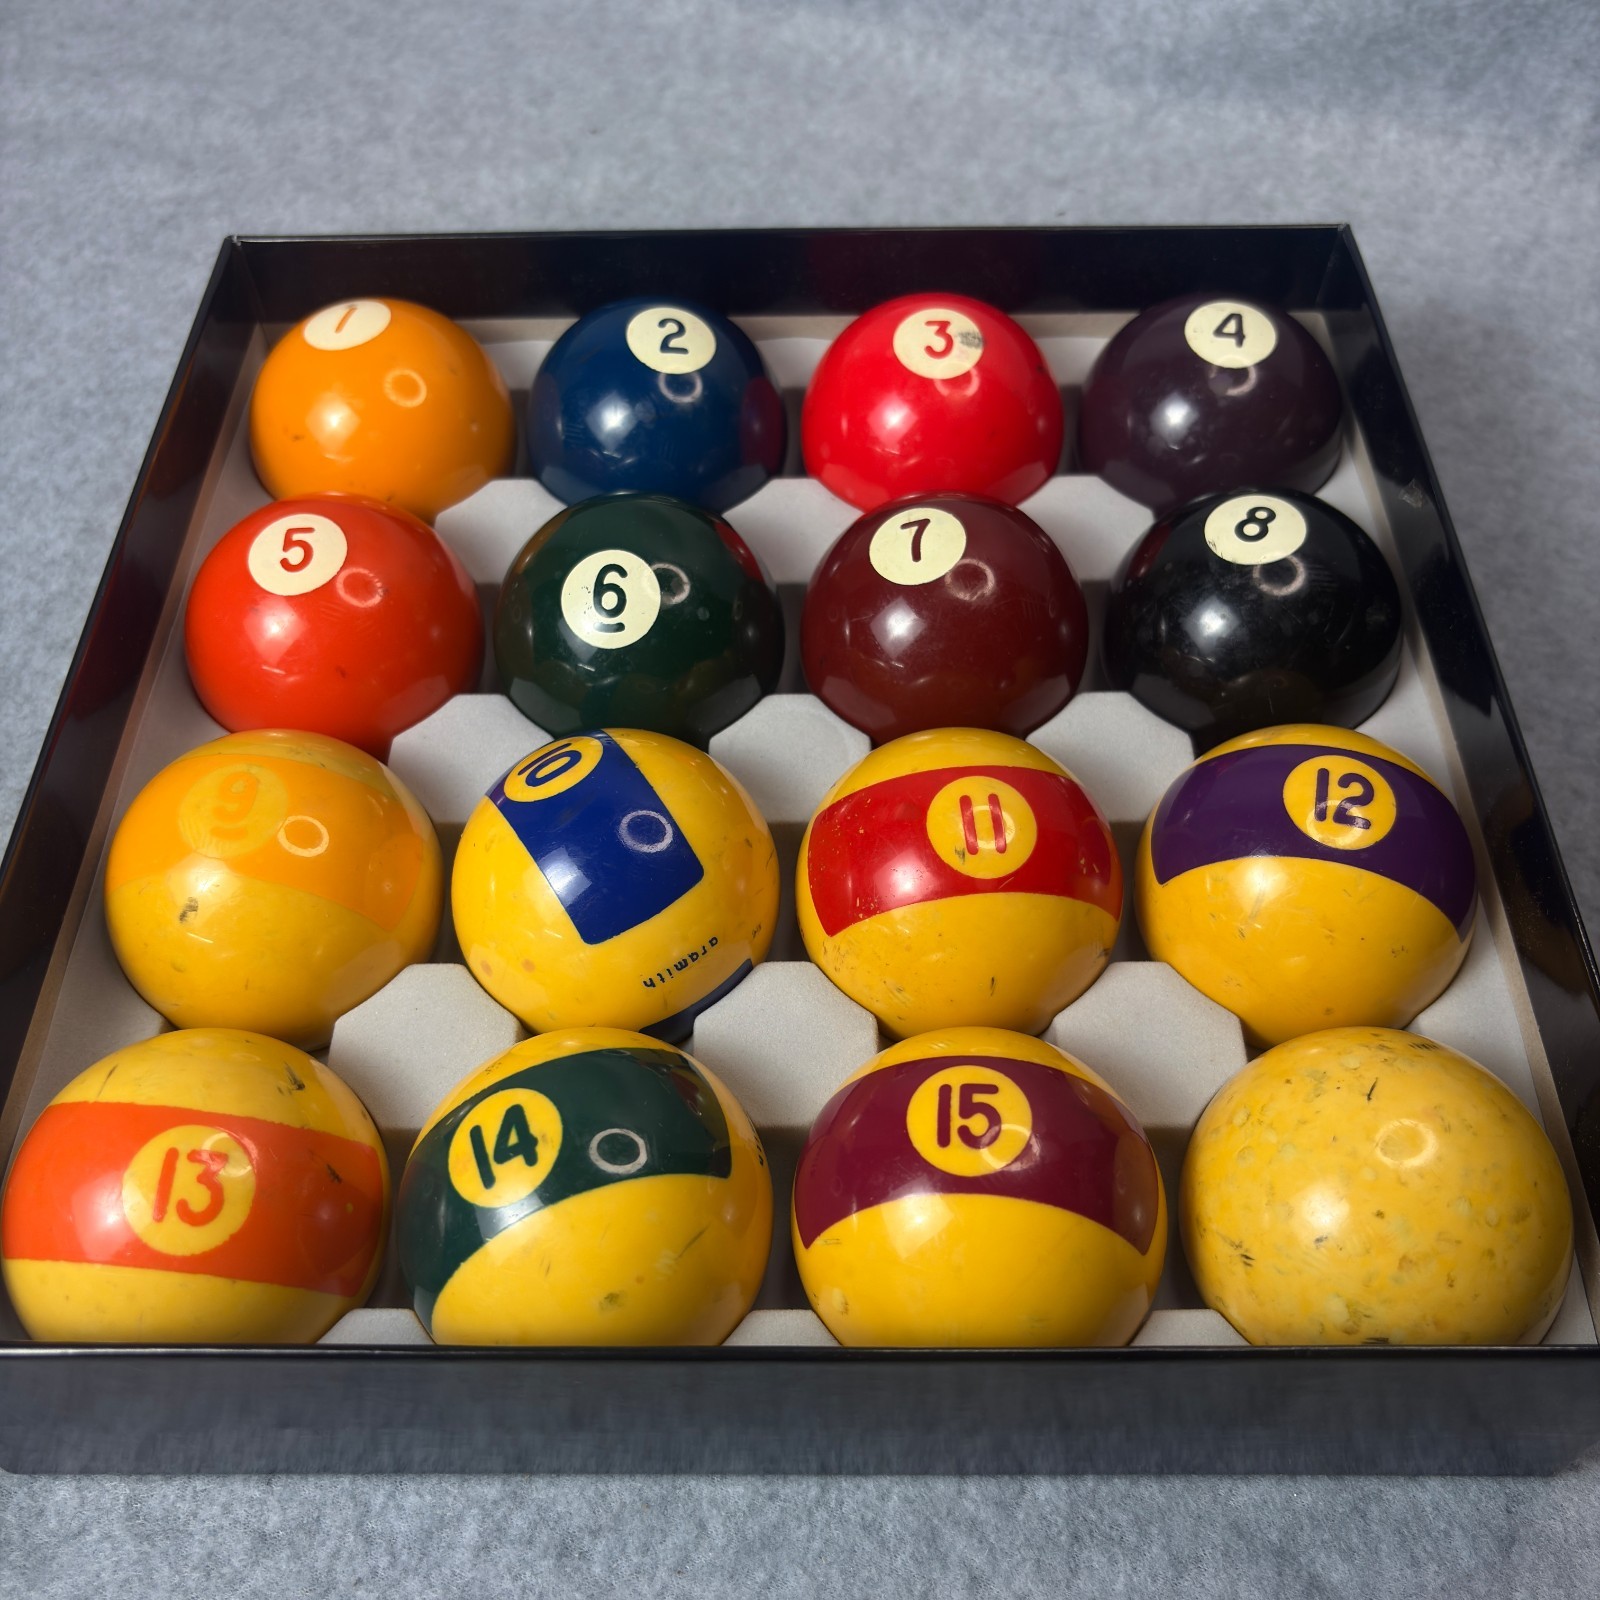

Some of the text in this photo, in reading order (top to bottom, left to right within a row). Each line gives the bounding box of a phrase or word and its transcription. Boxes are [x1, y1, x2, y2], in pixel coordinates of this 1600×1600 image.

[335, 304, 356, 334] 1
[658, 318, 689, 354] 2
[924, 320, 954, 359] 3
[1213, 313, 1245, 348] 4
[900, 518, 930, 562] 7
[1235, 506, 1276, 542] 8
[279, 527, 315, 572] 5
[593, 563, 628, 619] 6
[517, 742, 582, 787] 10
[217, 771, 259, 818] 9
[1314, 767, 1375, 830] 12
[959, 793, 1007, 855] 11
[643, 936, 719, 989] aramith
[937, 1083, 1002, 1150] 15
[470, 1103, 538, 1189] 14
[152, 1147, 229, 1227] 13
